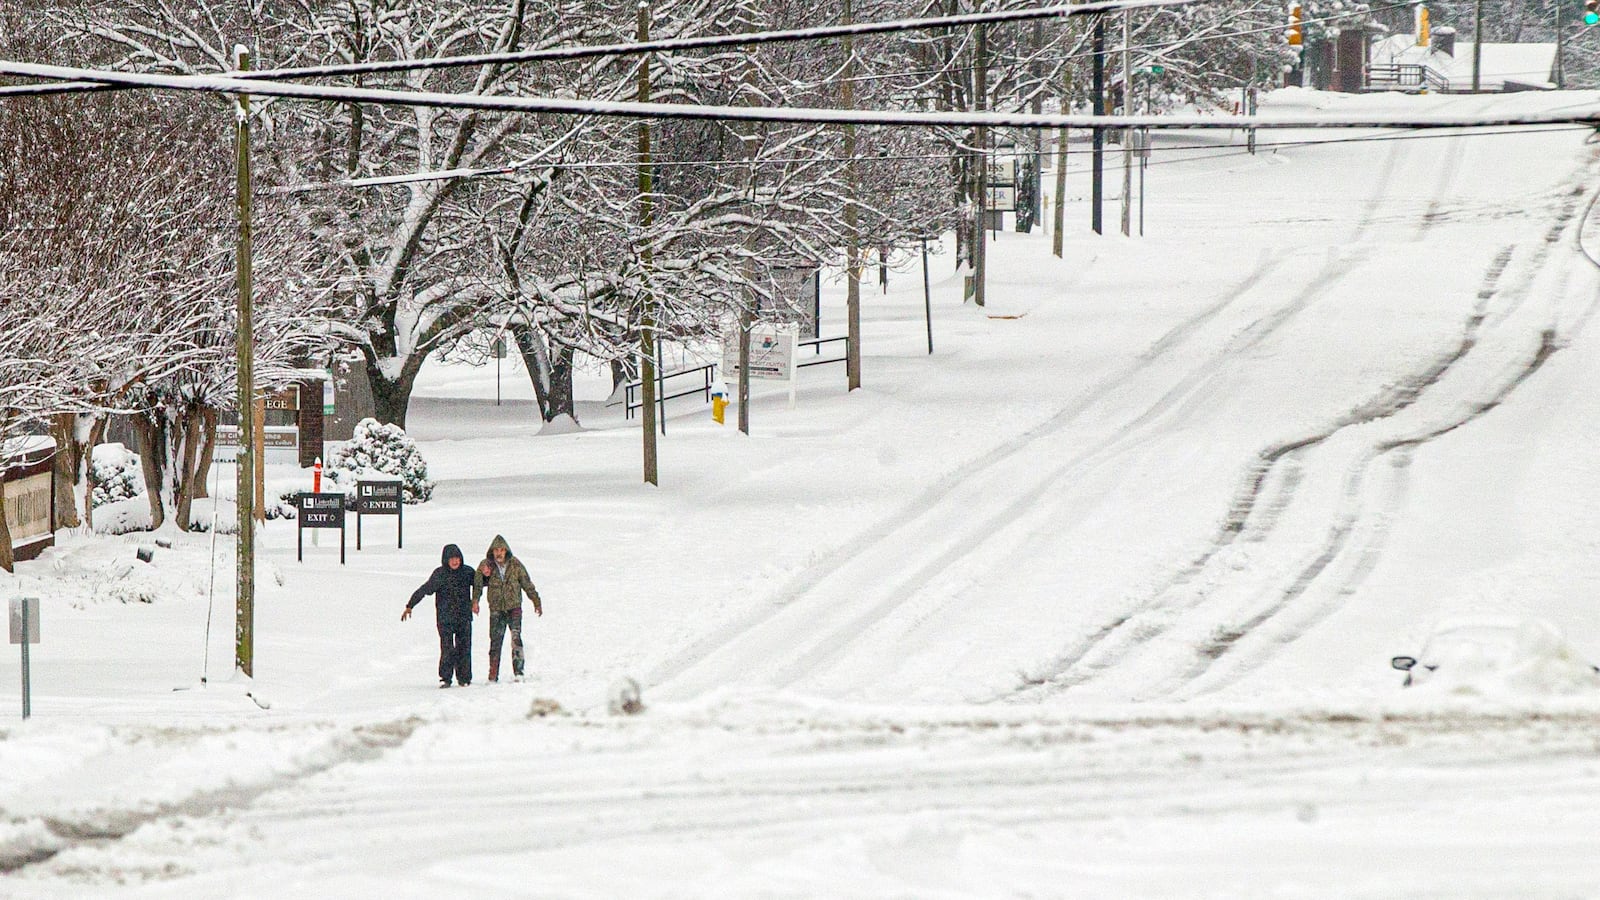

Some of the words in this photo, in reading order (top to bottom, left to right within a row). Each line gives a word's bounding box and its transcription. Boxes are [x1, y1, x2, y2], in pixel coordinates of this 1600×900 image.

[265, 400, 288, 409] EGE
[369, 501, 397, 509] ENTER
[307, 513, 328, 522] EXIT
